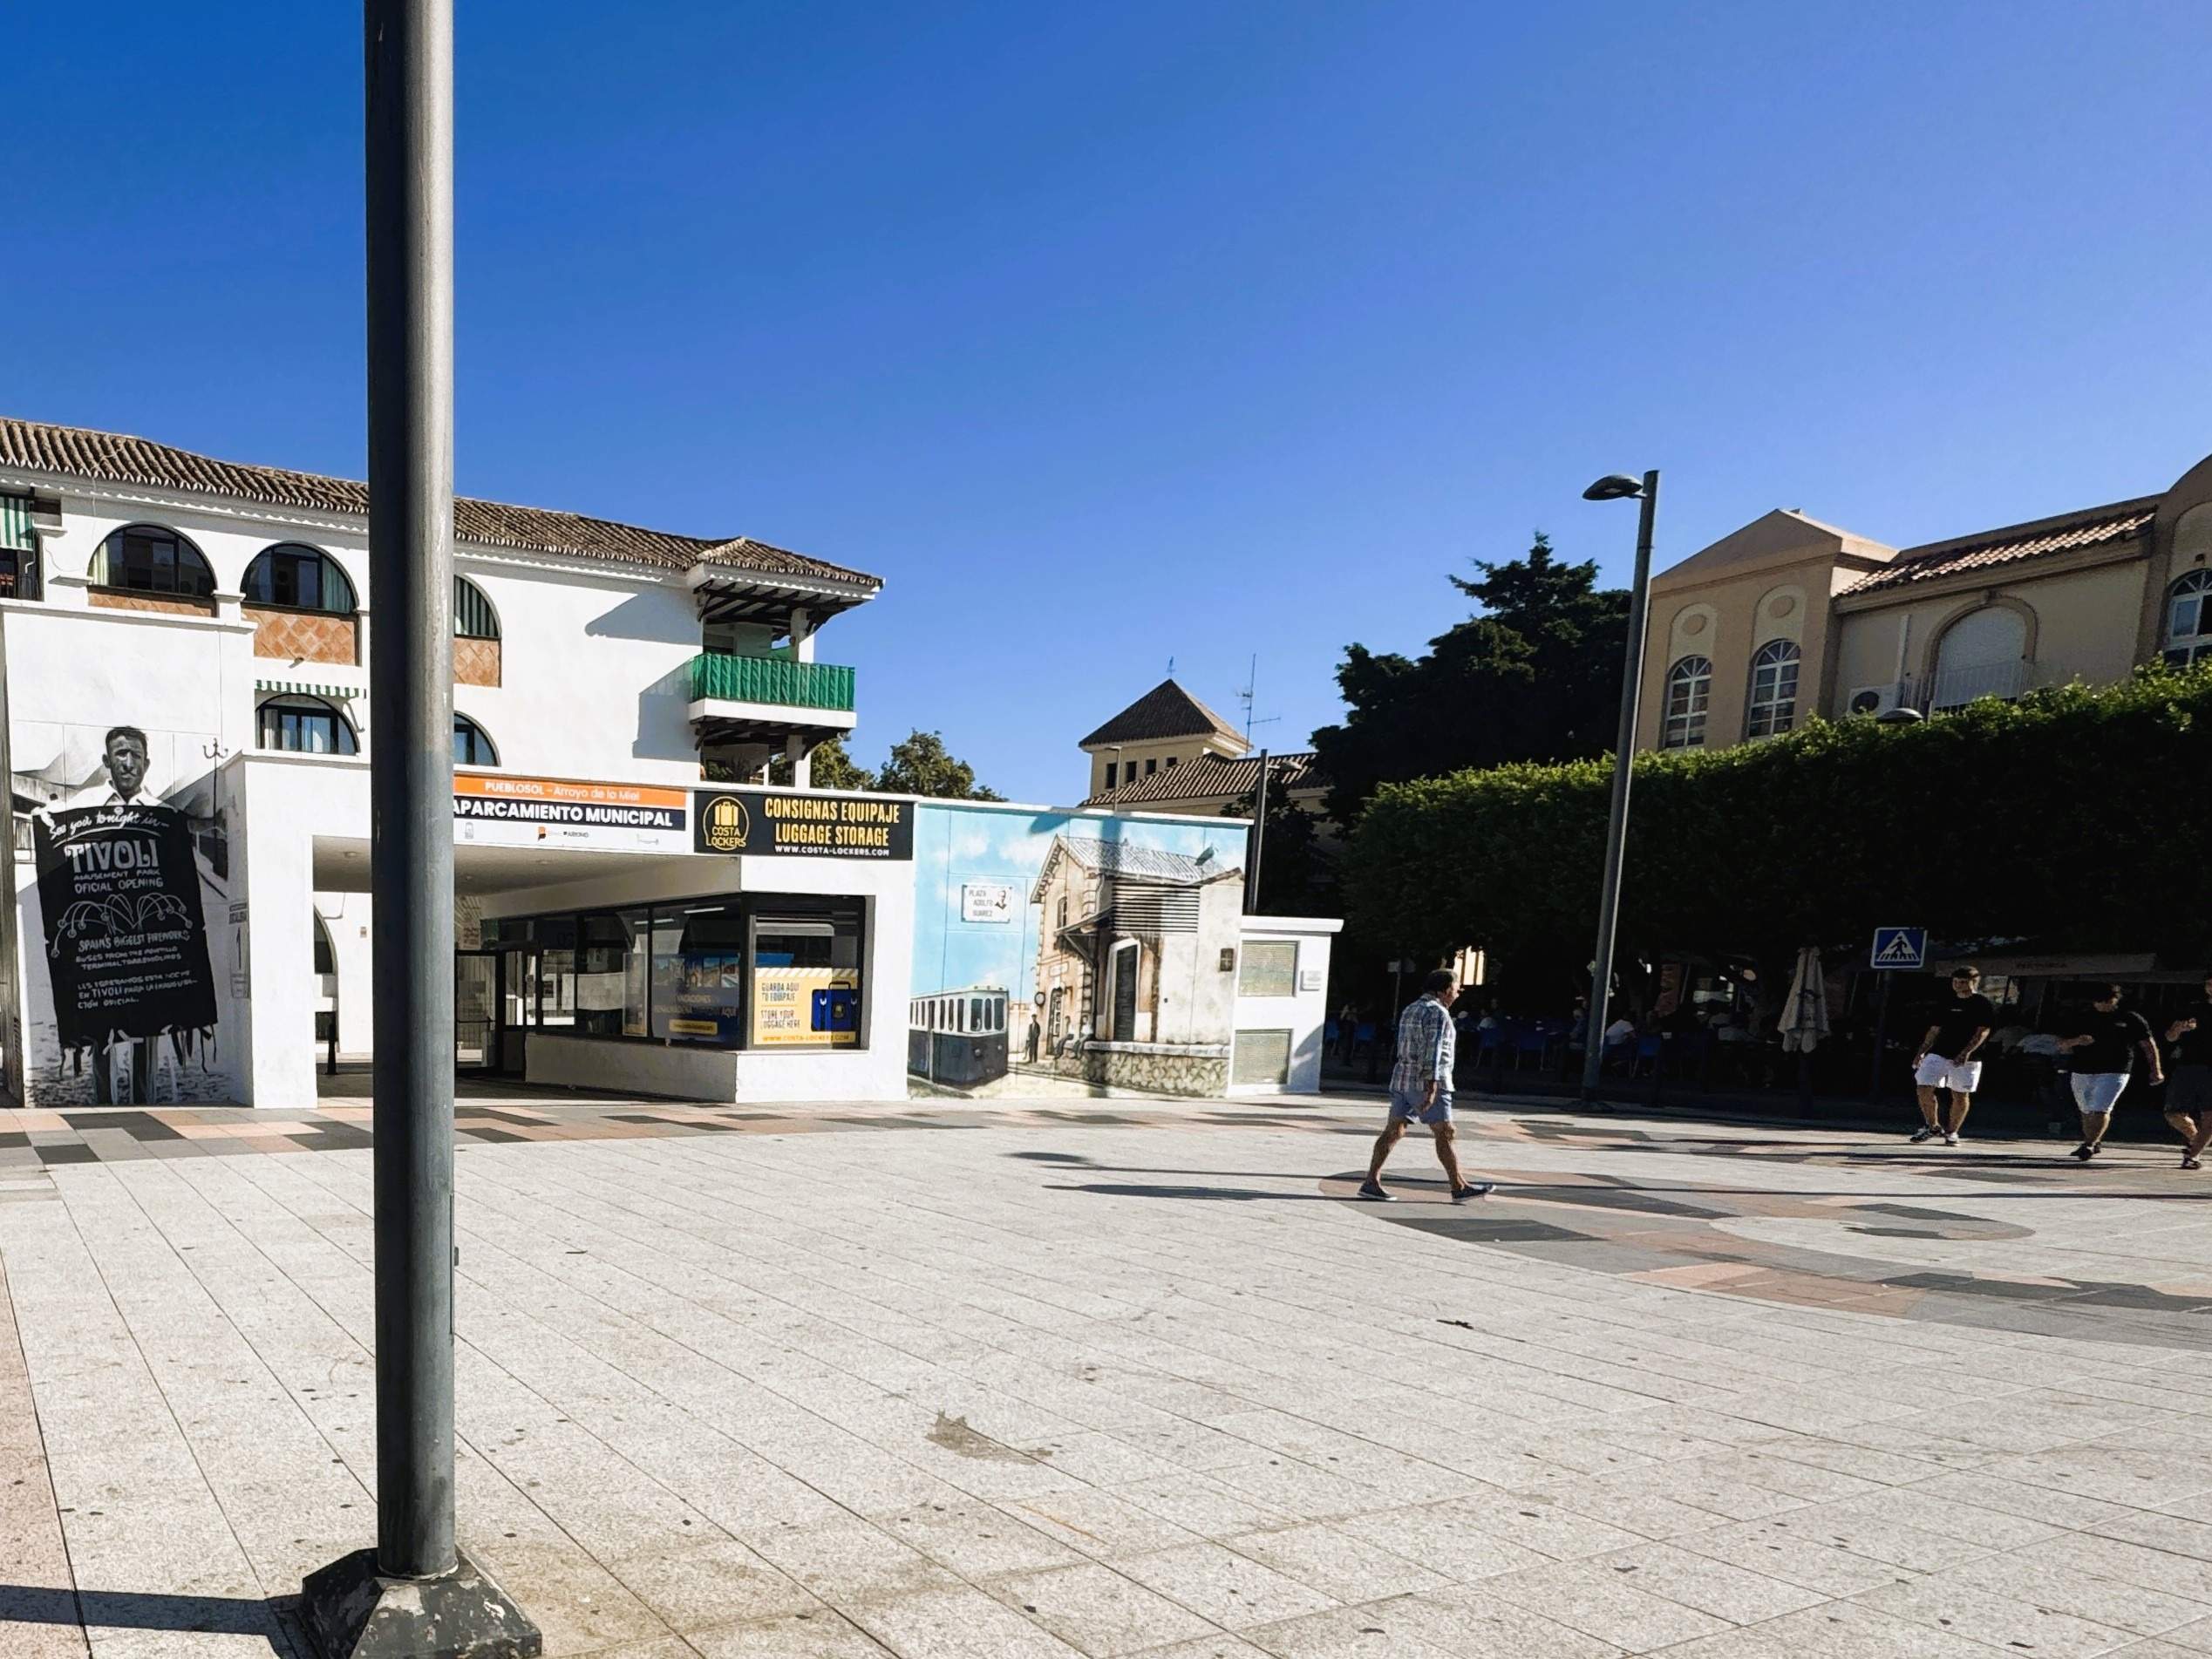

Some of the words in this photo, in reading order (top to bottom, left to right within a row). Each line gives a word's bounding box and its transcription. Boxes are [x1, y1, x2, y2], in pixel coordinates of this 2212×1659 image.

[485, 781, 545, 796] PUEBLOSOL
[554, 785, 590, 800] Arroyo
[592, 788, 604, 799] de
[607, 789, 617, 799] la
[619, 791, 641, 801] Miel
[453, 799, 583, 822] APARCAMIENTO
[585, 806, 673, 827] MUNICIPAL
[765, 798, 838, 820] CONSIGNAS
[841, 802, 900, 824] EQUIPAJE
[50, 823, 67, 840] See
[70, 815, 92, 835] you
[96, 806, 140, 829] tonight
[711, 826, 741, 837] COSTA
[705, 836, 747, 848] LOCKERS
[775, 823, 832, 845] LUGGAGE
[835, 826, 889, 846] STORAGE
[64, 839, 159, 873] TIVOLI
[774, 845, 889, 857] WWW.COSTA-LOCKERS.COM
[73, 870, 128, 881] AMUSEMENT
[137, 868, 161, 877] PARK
[74, 882, 112, 894] OFICIAL
[119, 877, 164, 890] OPENING
[78, 934, 112, 952] SPAIN'S
[113, 934, 146, 948] BIGGEST
[91, 986, 123, 998] TIVOLI
